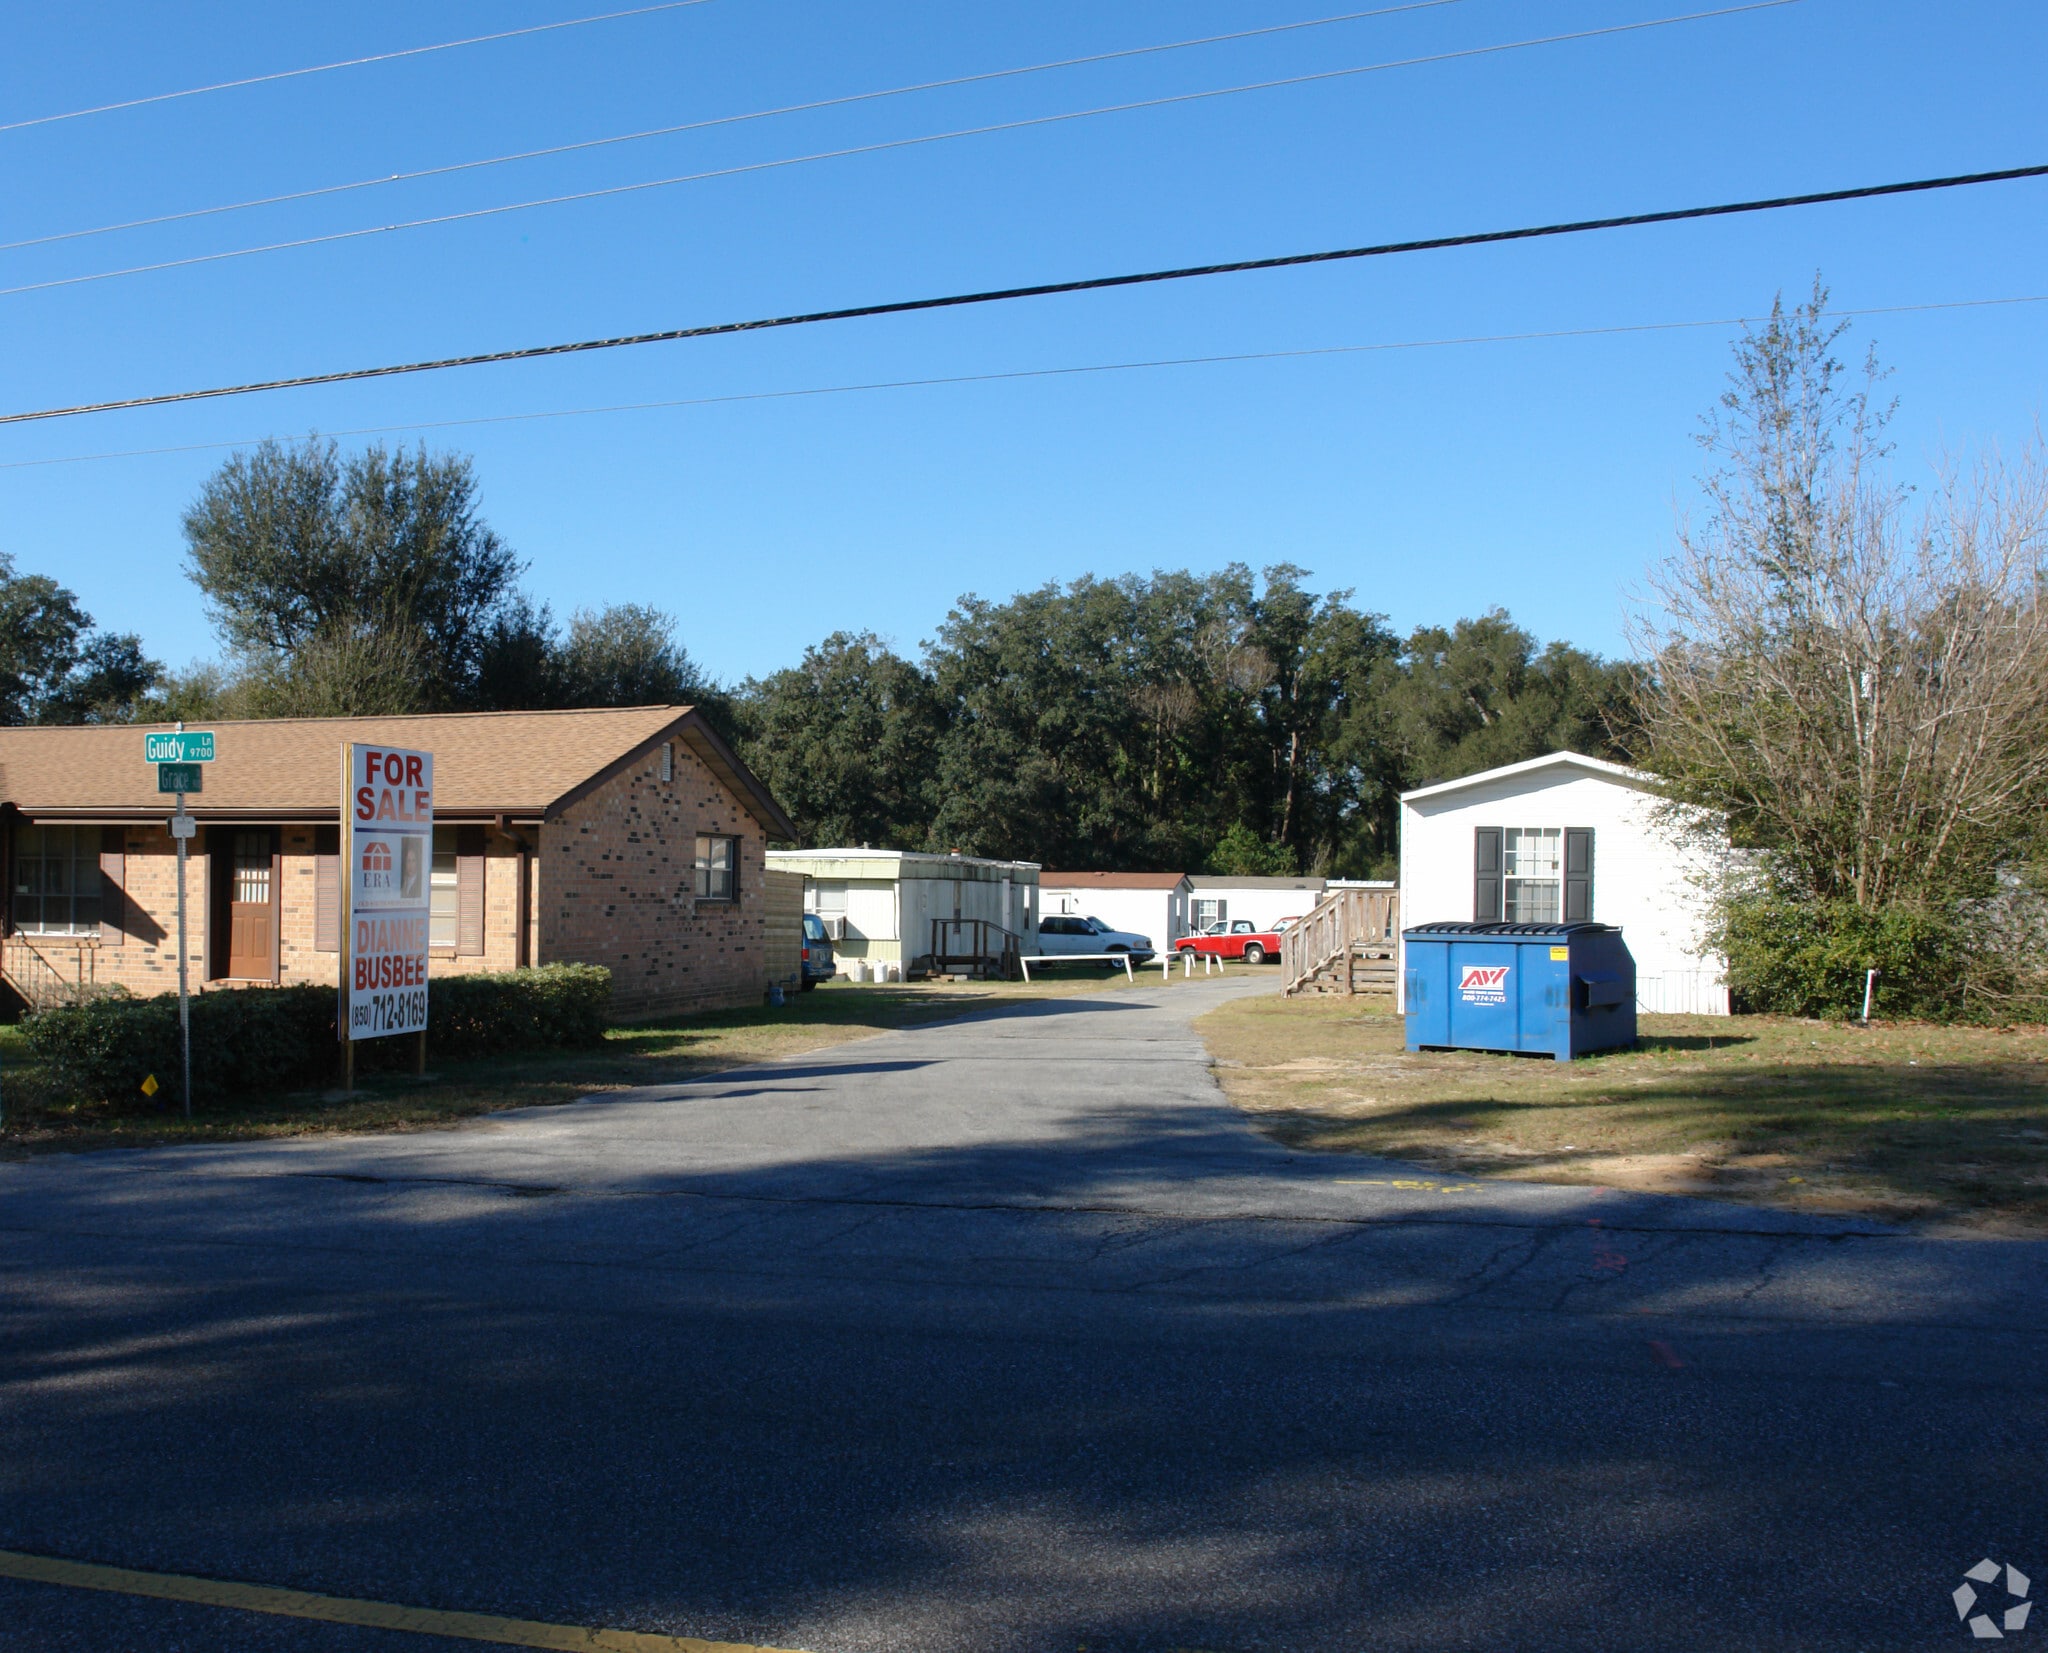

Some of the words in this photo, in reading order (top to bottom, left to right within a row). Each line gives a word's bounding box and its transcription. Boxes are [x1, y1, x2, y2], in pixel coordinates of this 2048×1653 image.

[148, 738, 185, 761] Guidy
[202, 736, 211, 746] Ln
[190, 748, 212, 757] 9700
[161, 767, 189, 790] Grace
[366, 752, 424, 787] FOR
[356, 787, 430, 823] SALE
[363, 872, 391, 889] ERA
[357, 918, 425, 954] DIANNE
[355, 953, 425, 991] BUSBEE
[1461, 968, 1508, 988] AW
[352, 1002, 371, 1029] (850)
[373, 990, 425, 1031] 712-8169
